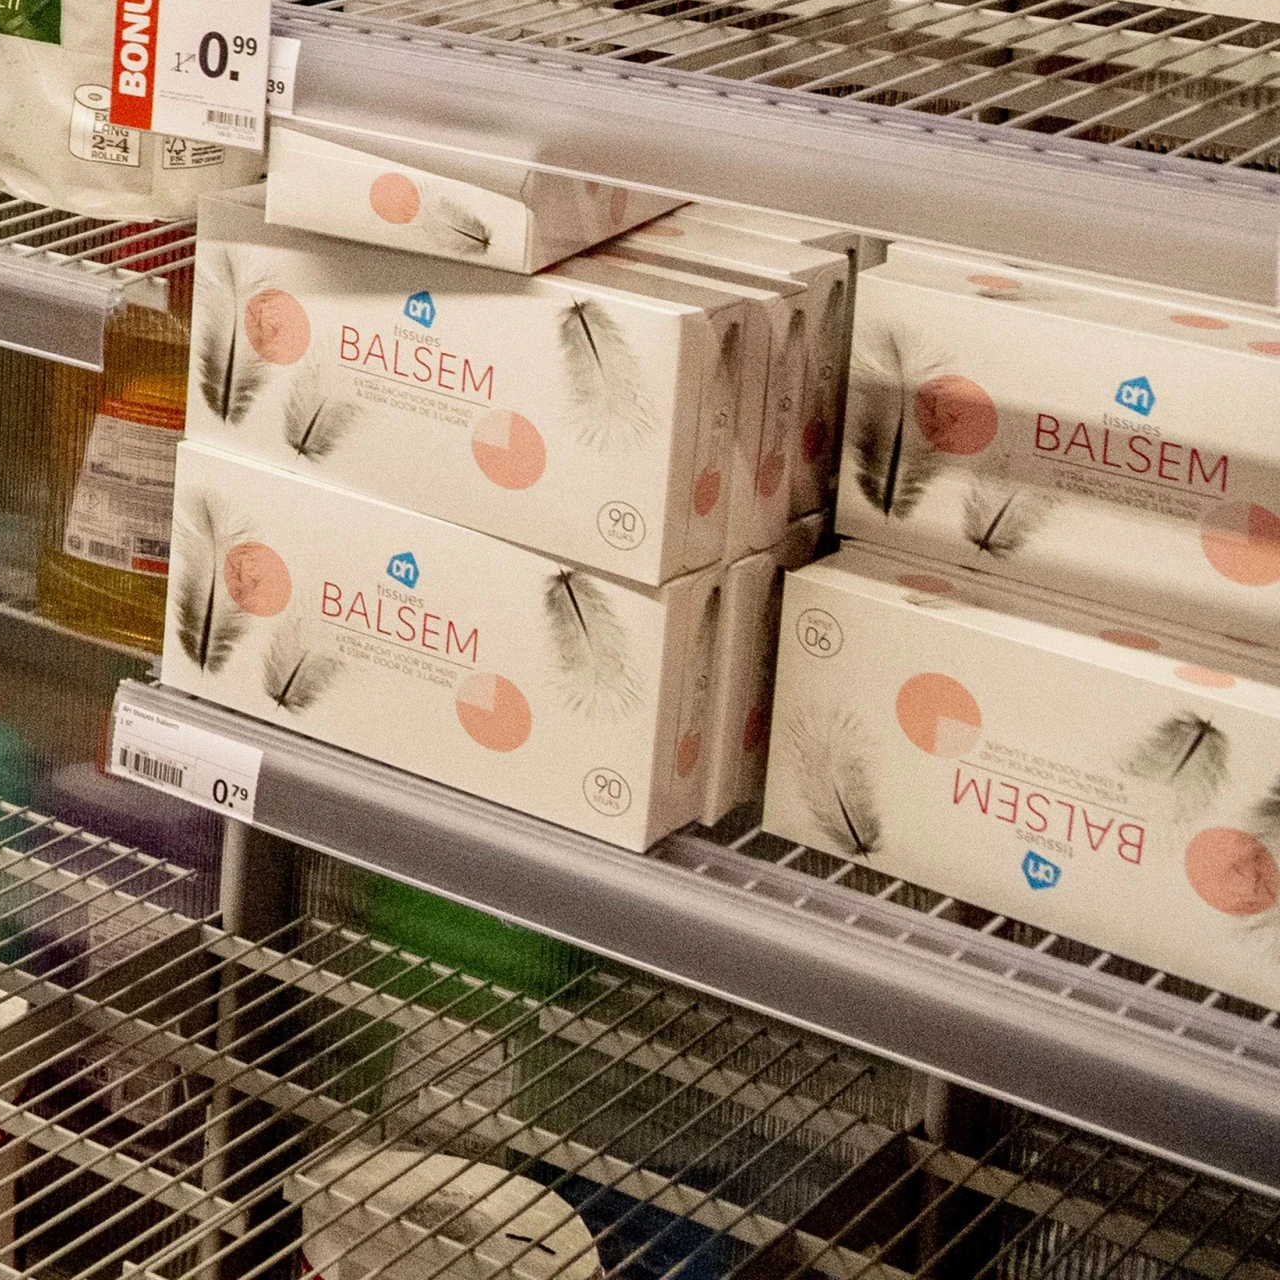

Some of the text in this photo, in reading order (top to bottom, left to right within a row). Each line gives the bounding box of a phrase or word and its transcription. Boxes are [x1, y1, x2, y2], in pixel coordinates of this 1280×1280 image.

[198, 30, 258, 82] 0.99
[92, 124, 130, 138] LANG
[91, 151, 129, 163] ROLLEN
[92, 135, 130, 154] 2=4
[393, 323, 442, 348] tissues
[340, 325, 494, 400] BALSEM
[1103, 412, 1162, 438] tissues
[1035, 413, 1229, 492] BALSEM
[608, 508, 637, 533] 90
[376, 583, 426, 609] tissues
[322, 581, 478, 663] BALSEM
[212, 778, 249, 809] 0.79
[594, 773, 621, 799] 90
[952, 768, 1145, 865] BALSEM
[1014, 827, 1074, 860] tissues
